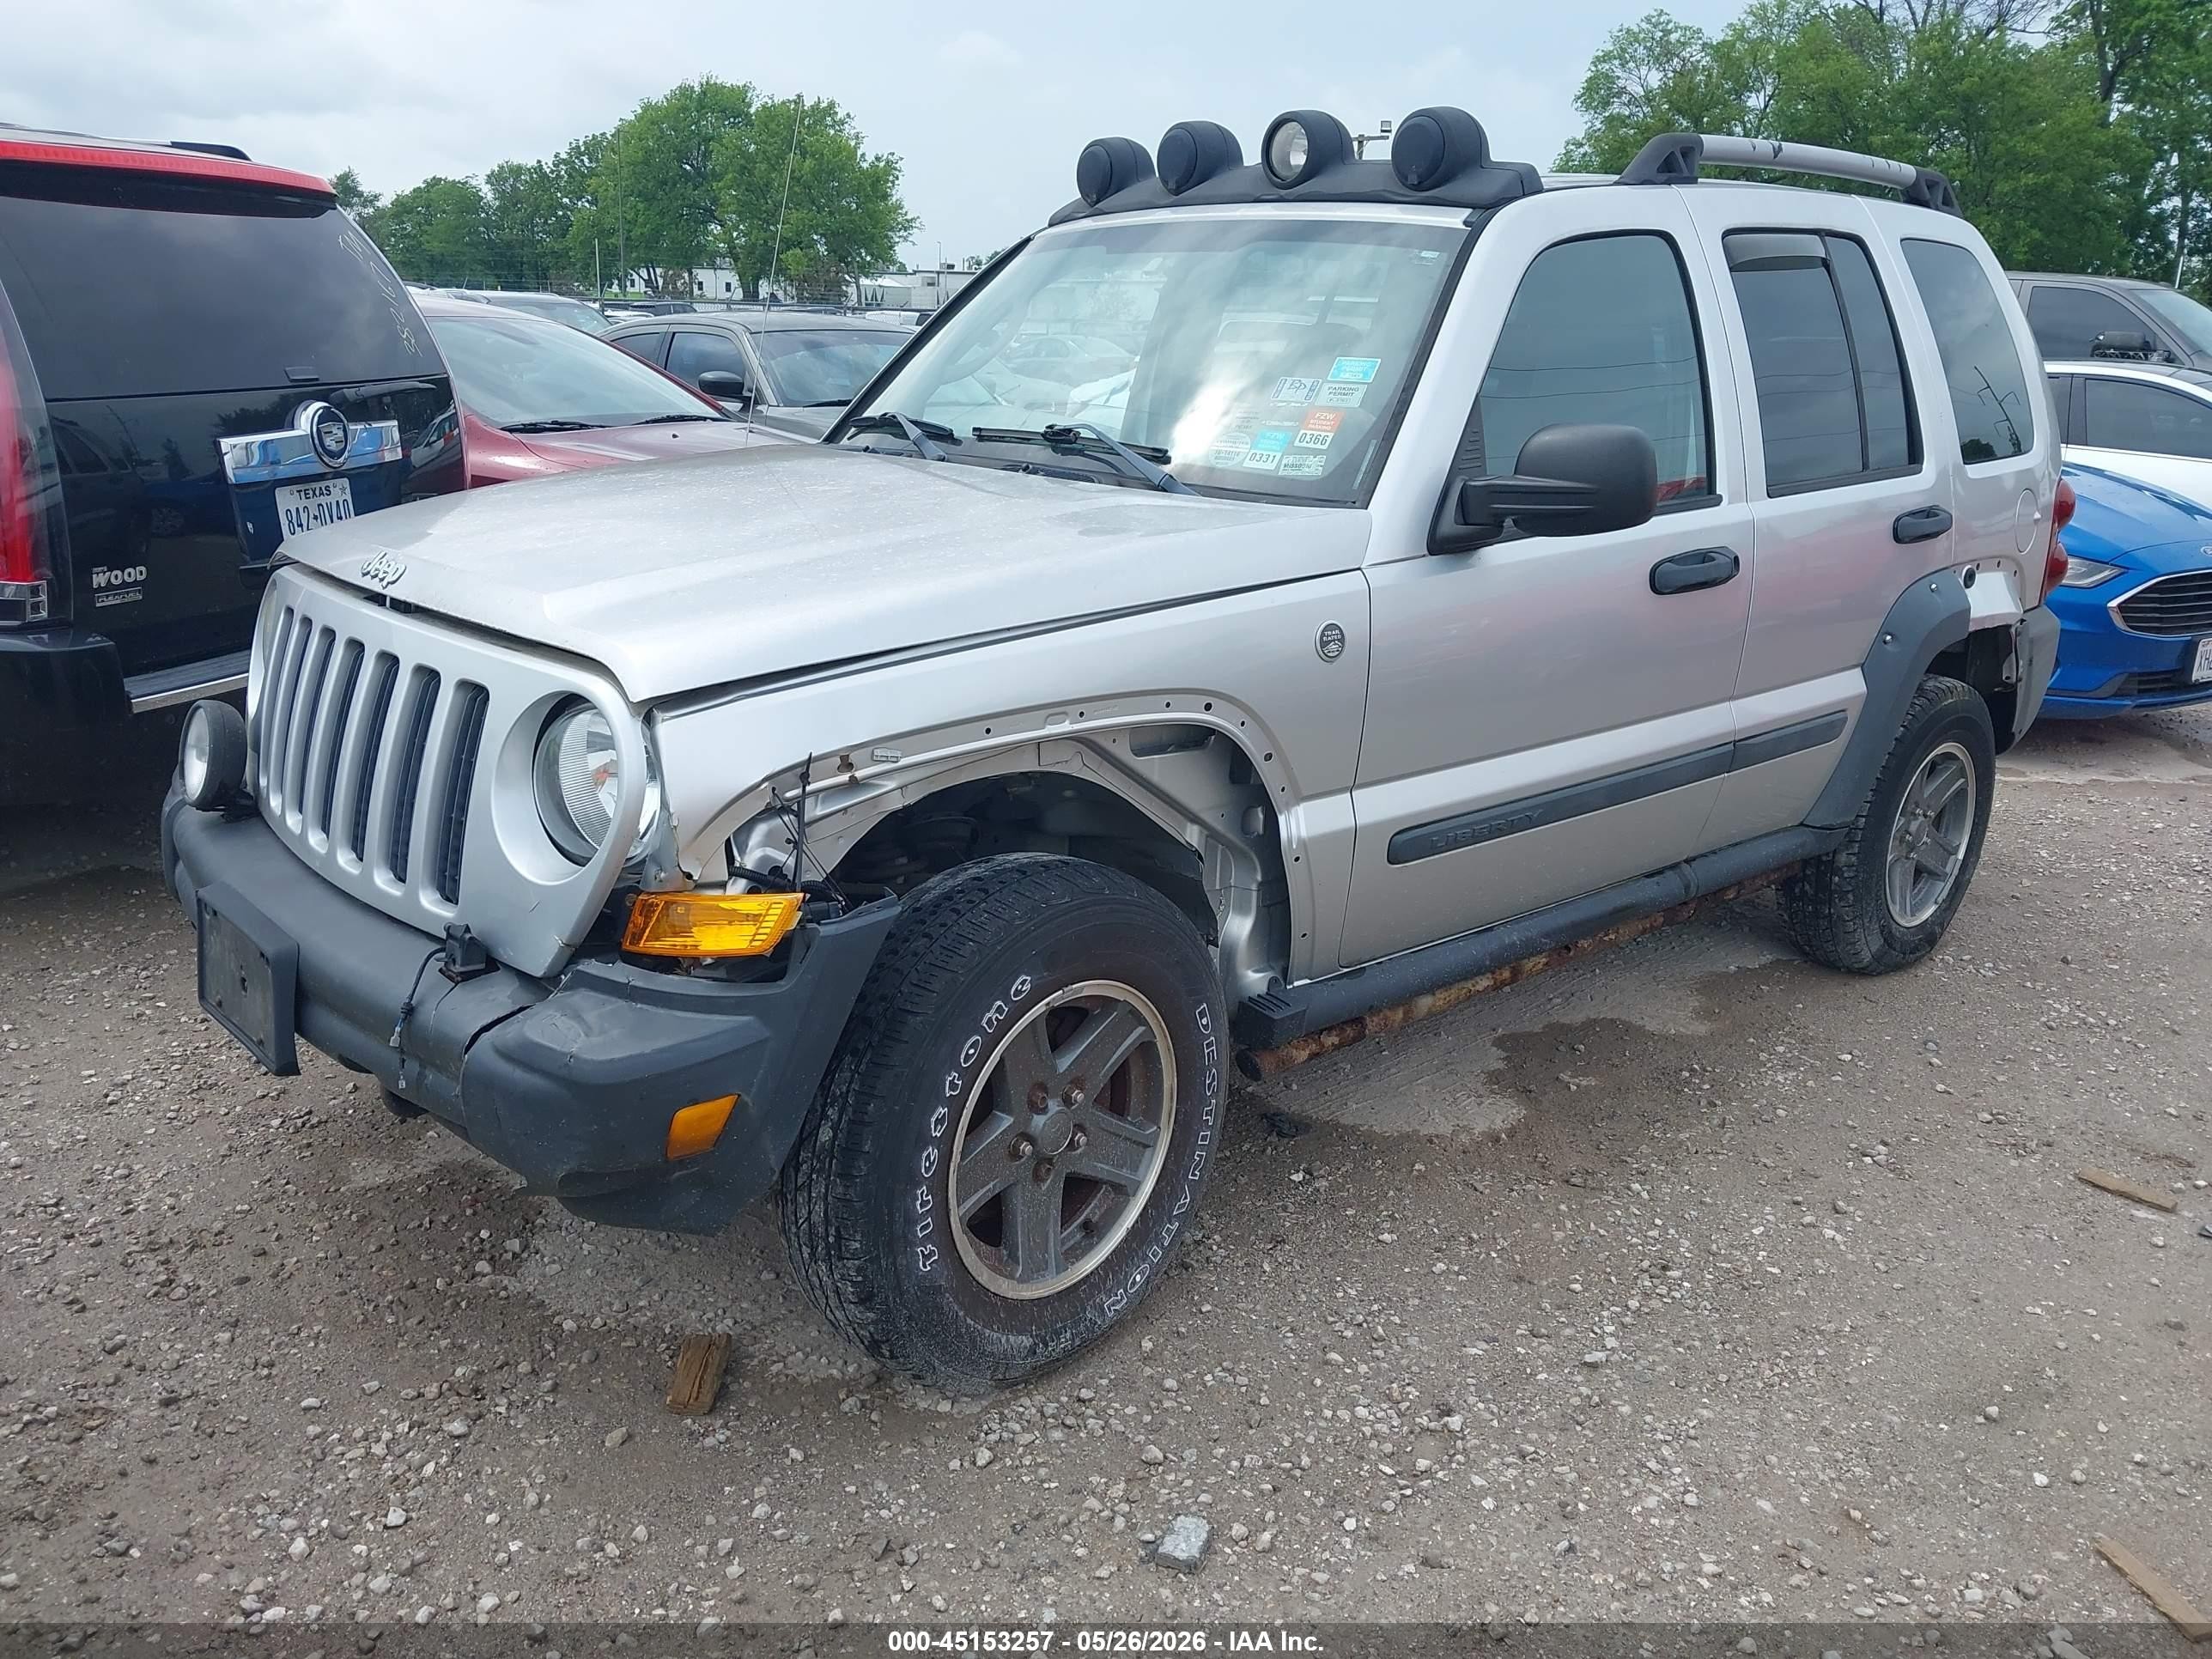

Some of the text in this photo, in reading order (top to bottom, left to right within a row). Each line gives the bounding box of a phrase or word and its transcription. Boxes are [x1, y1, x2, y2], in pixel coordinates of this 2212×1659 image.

[1315, 412, 1337, 421] FZW
[1297, 432, 1330, 447] 0366
[1249, 452, 1277, 465] 0331
[296, 485, 332, 501] TEXAS
[92, 565, 148, 588] WOOD
[361, 550, 408, 590] Jeep
[1429, 808, 1545, 850] LIBERTY
[1103, 1002, 1219, 1319] DESTINATION
